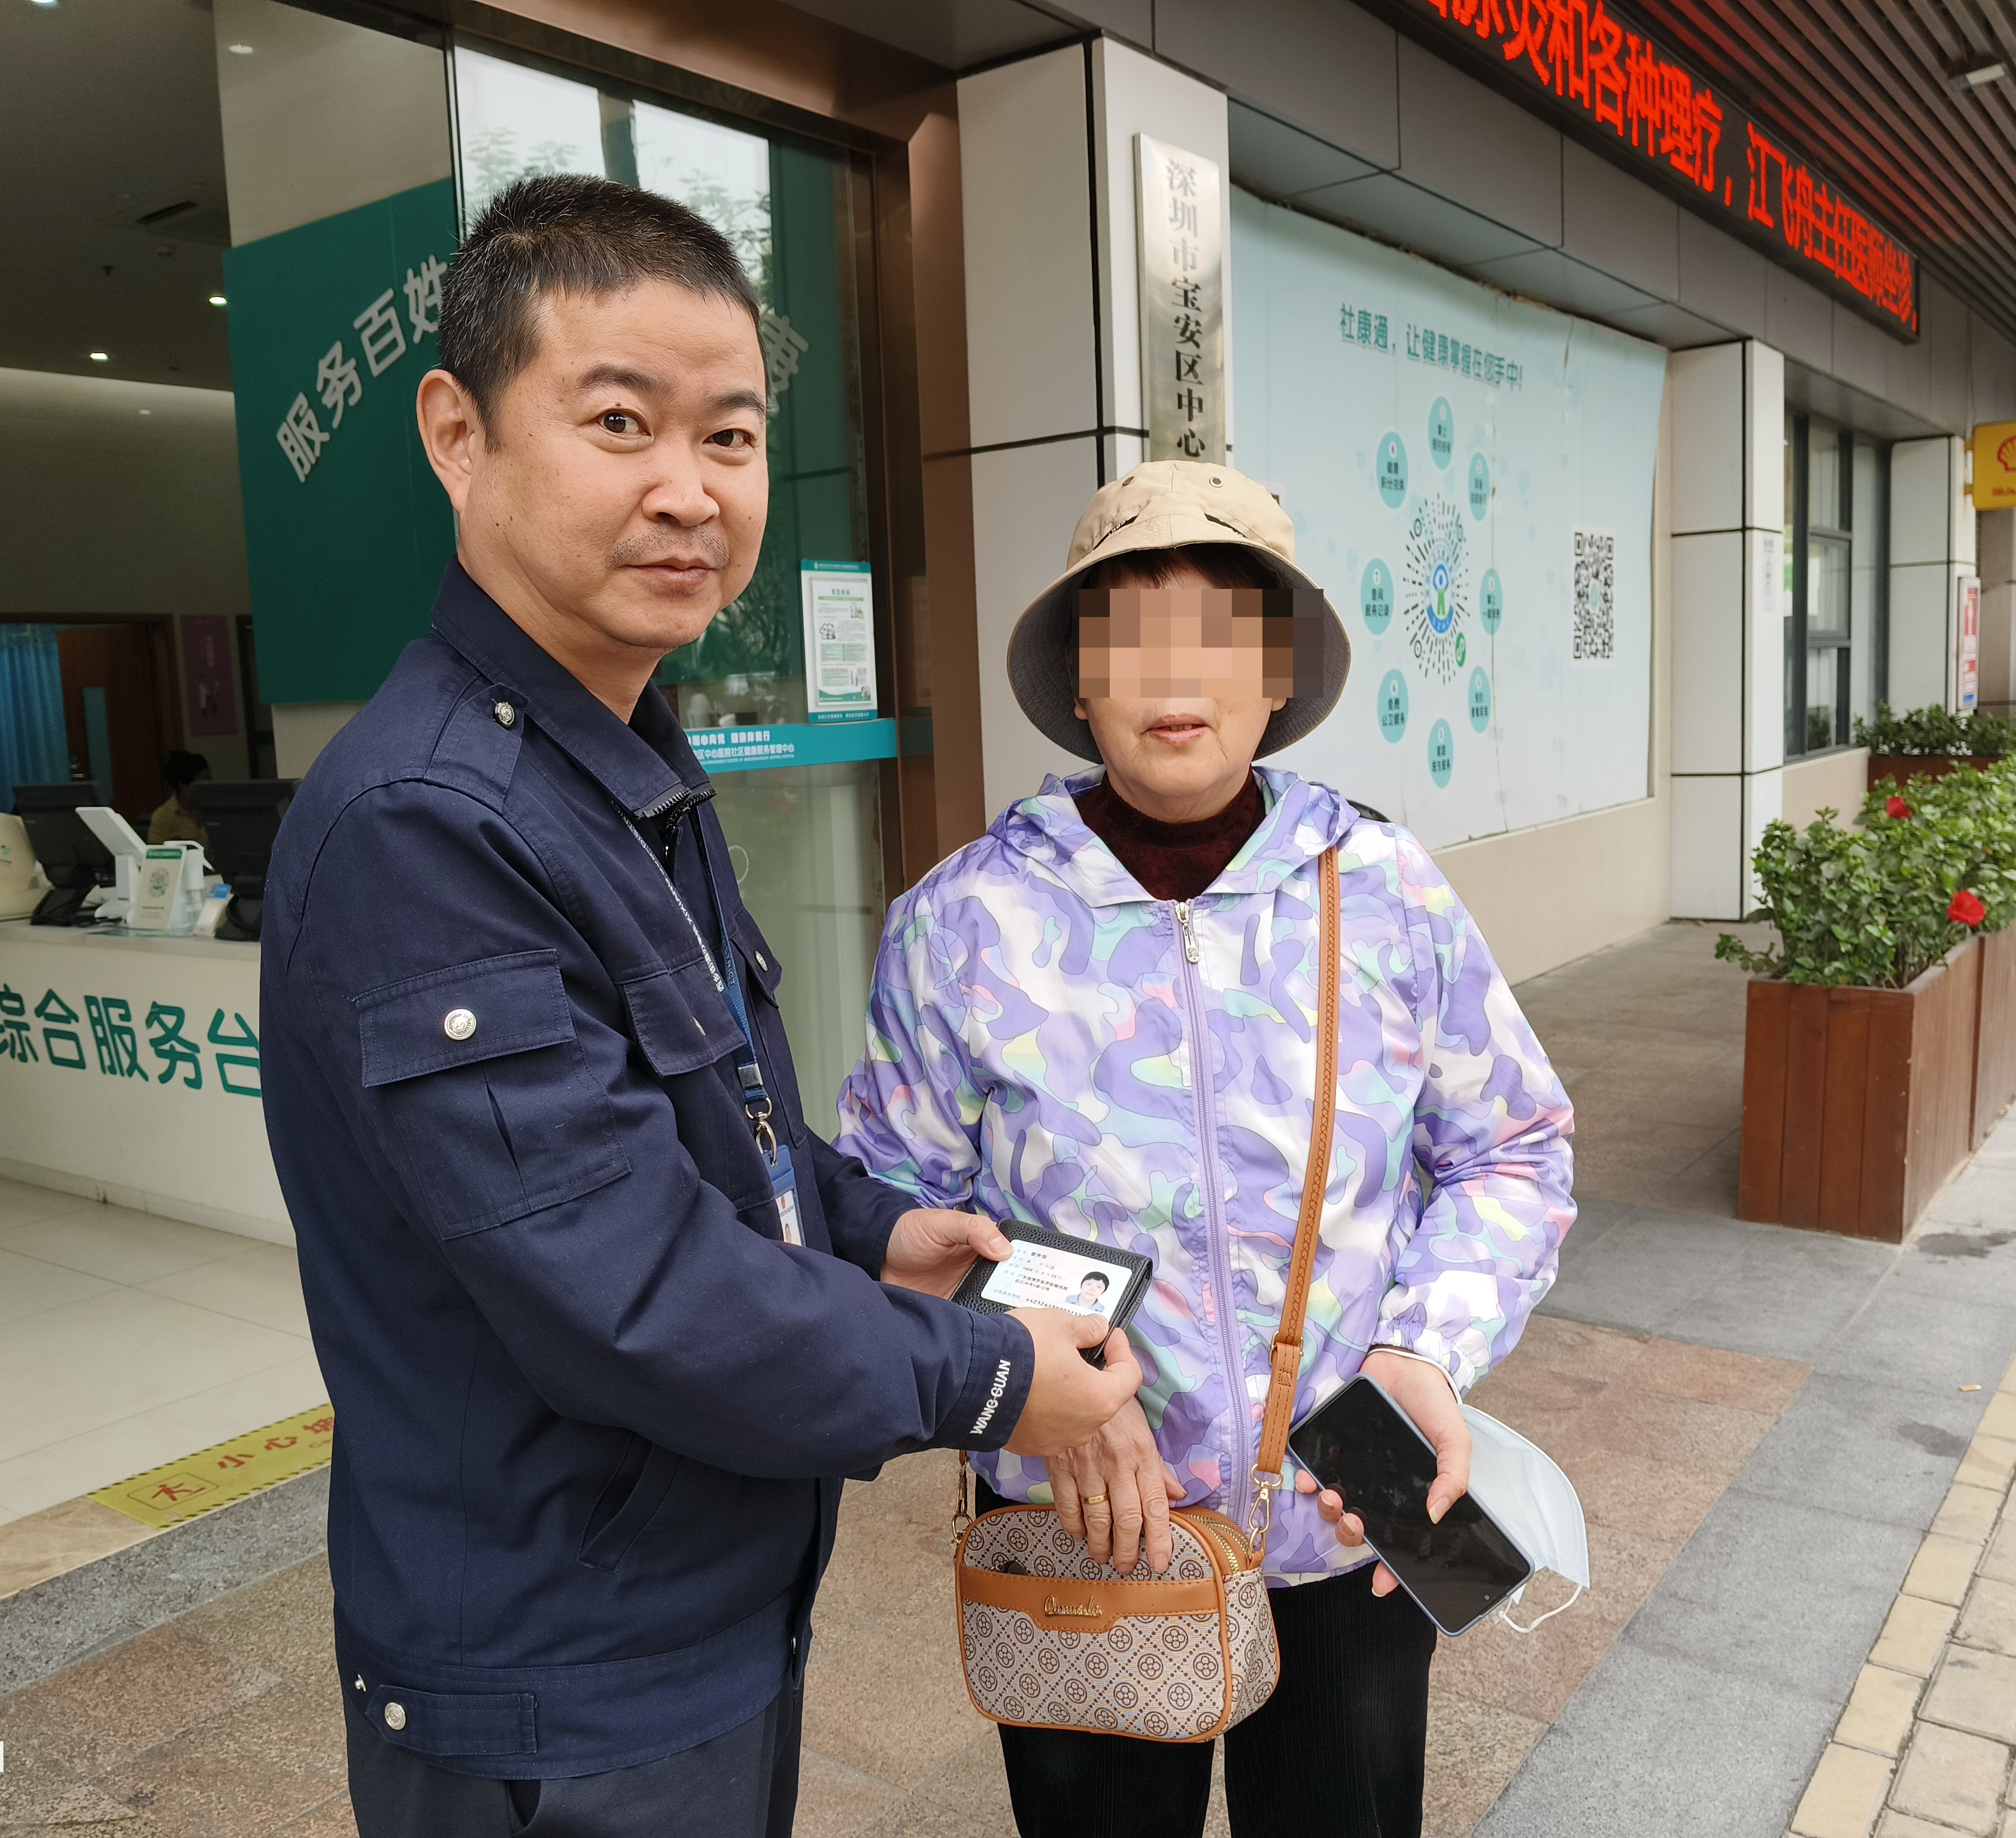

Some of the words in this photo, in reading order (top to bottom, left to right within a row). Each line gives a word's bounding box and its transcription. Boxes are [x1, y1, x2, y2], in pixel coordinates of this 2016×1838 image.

[275, 254, 448, 482] 服务百姓
[1166, 158, 1206, 457] 深圳市宝安区中心
[0, 983, 261, 1098] 综合服务台
